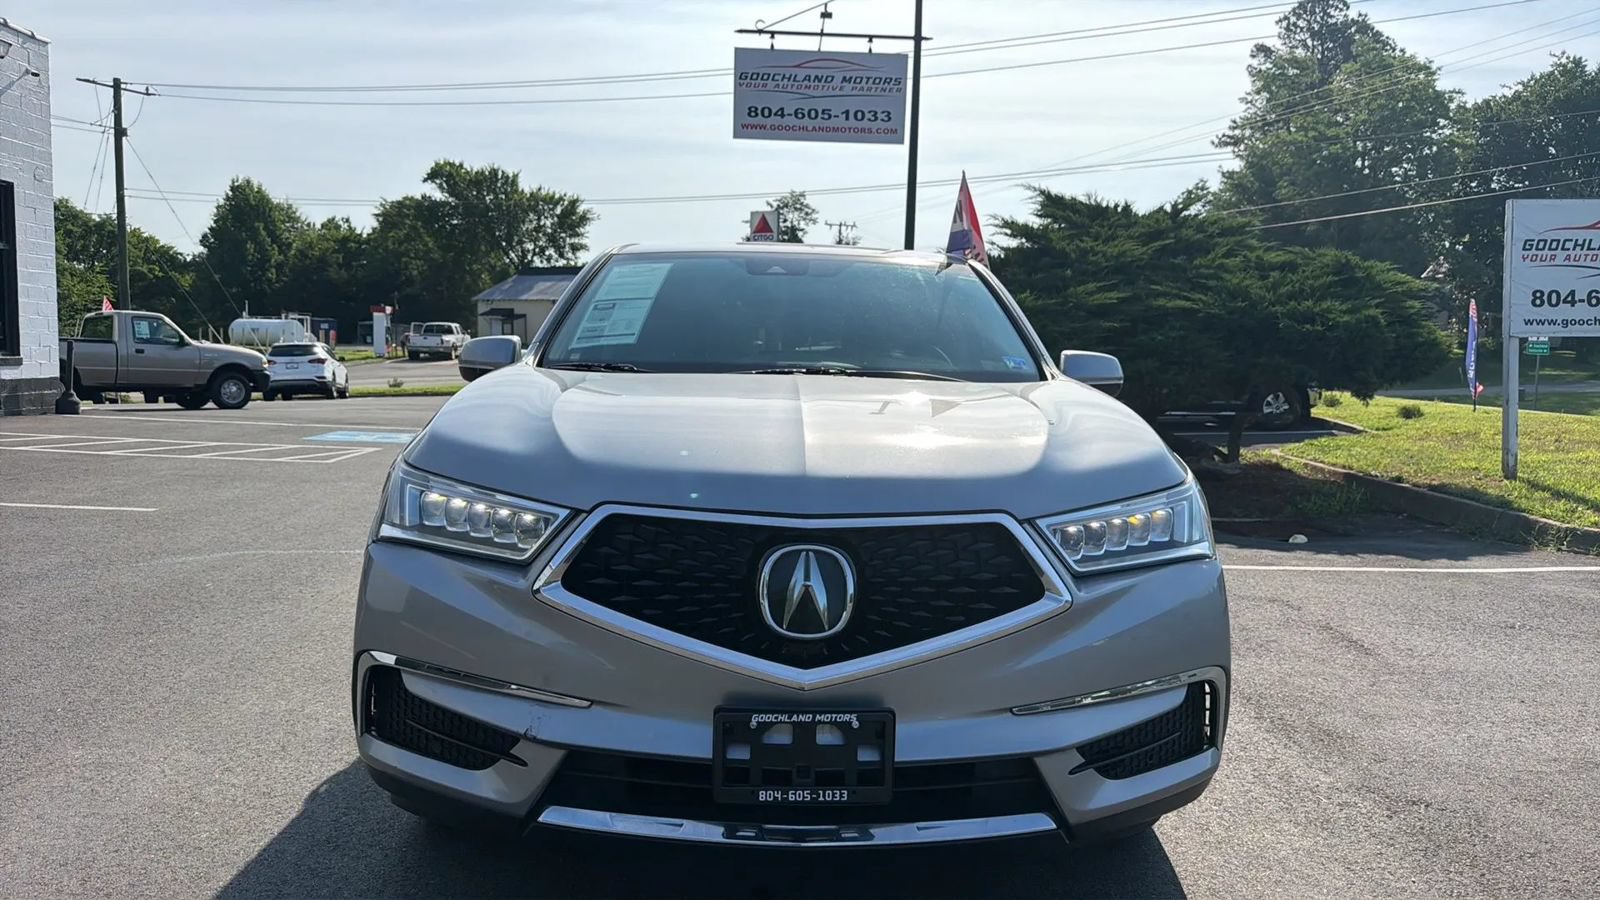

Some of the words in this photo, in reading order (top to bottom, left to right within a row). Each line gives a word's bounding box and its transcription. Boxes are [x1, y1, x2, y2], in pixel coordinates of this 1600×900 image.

[738, 71, 835, 84] GOOCHLAND
[840, 75, 903, 86] MOTORS
[773, 82, 848, 92] AUTOMOTIVE
[850, 85, 903, 94] PARTNER
[746, 105, 893, 123] 804-605-1033
[740, 122, 899, 136] WWW.GOOCHLANDMOTORS.COM
[1521, 254, 1557, 263] YOUR
[1563, 254, 1600, 263] AUTO
[1530, 288, 1600, 308] 804-6
[1523, 316, 1600, 329] www.gooch
[751, 713, 813, 723] GOOCHLAND
[815, 713, 858, 722] MOTORS
[758, 790, 848, 801] 804-605-1033
